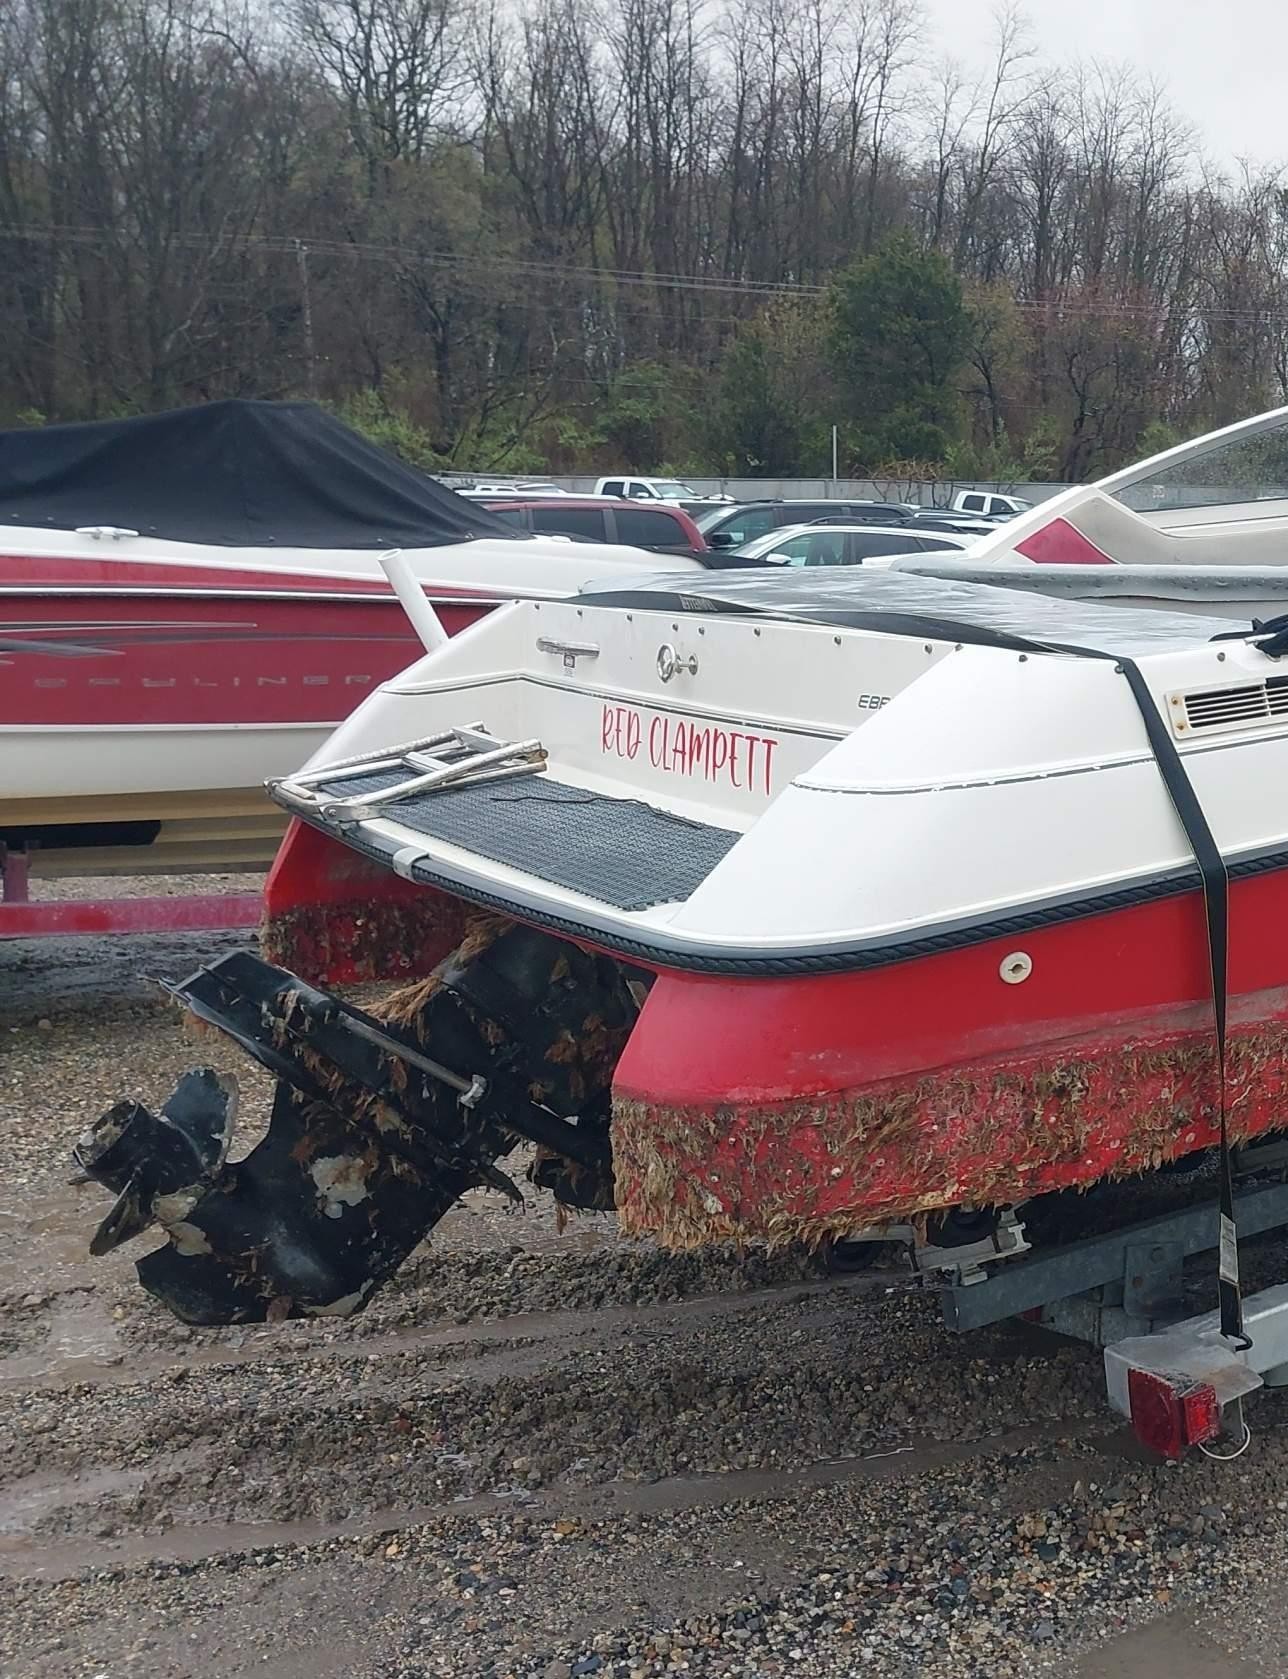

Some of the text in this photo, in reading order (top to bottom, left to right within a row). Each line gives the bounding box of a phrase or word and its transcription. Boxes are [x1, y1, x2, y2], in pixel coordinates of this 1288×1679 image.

[34, 674, 372, 689] BAYLINER
[602, 704, 779, 796] RED CLAMPETT
